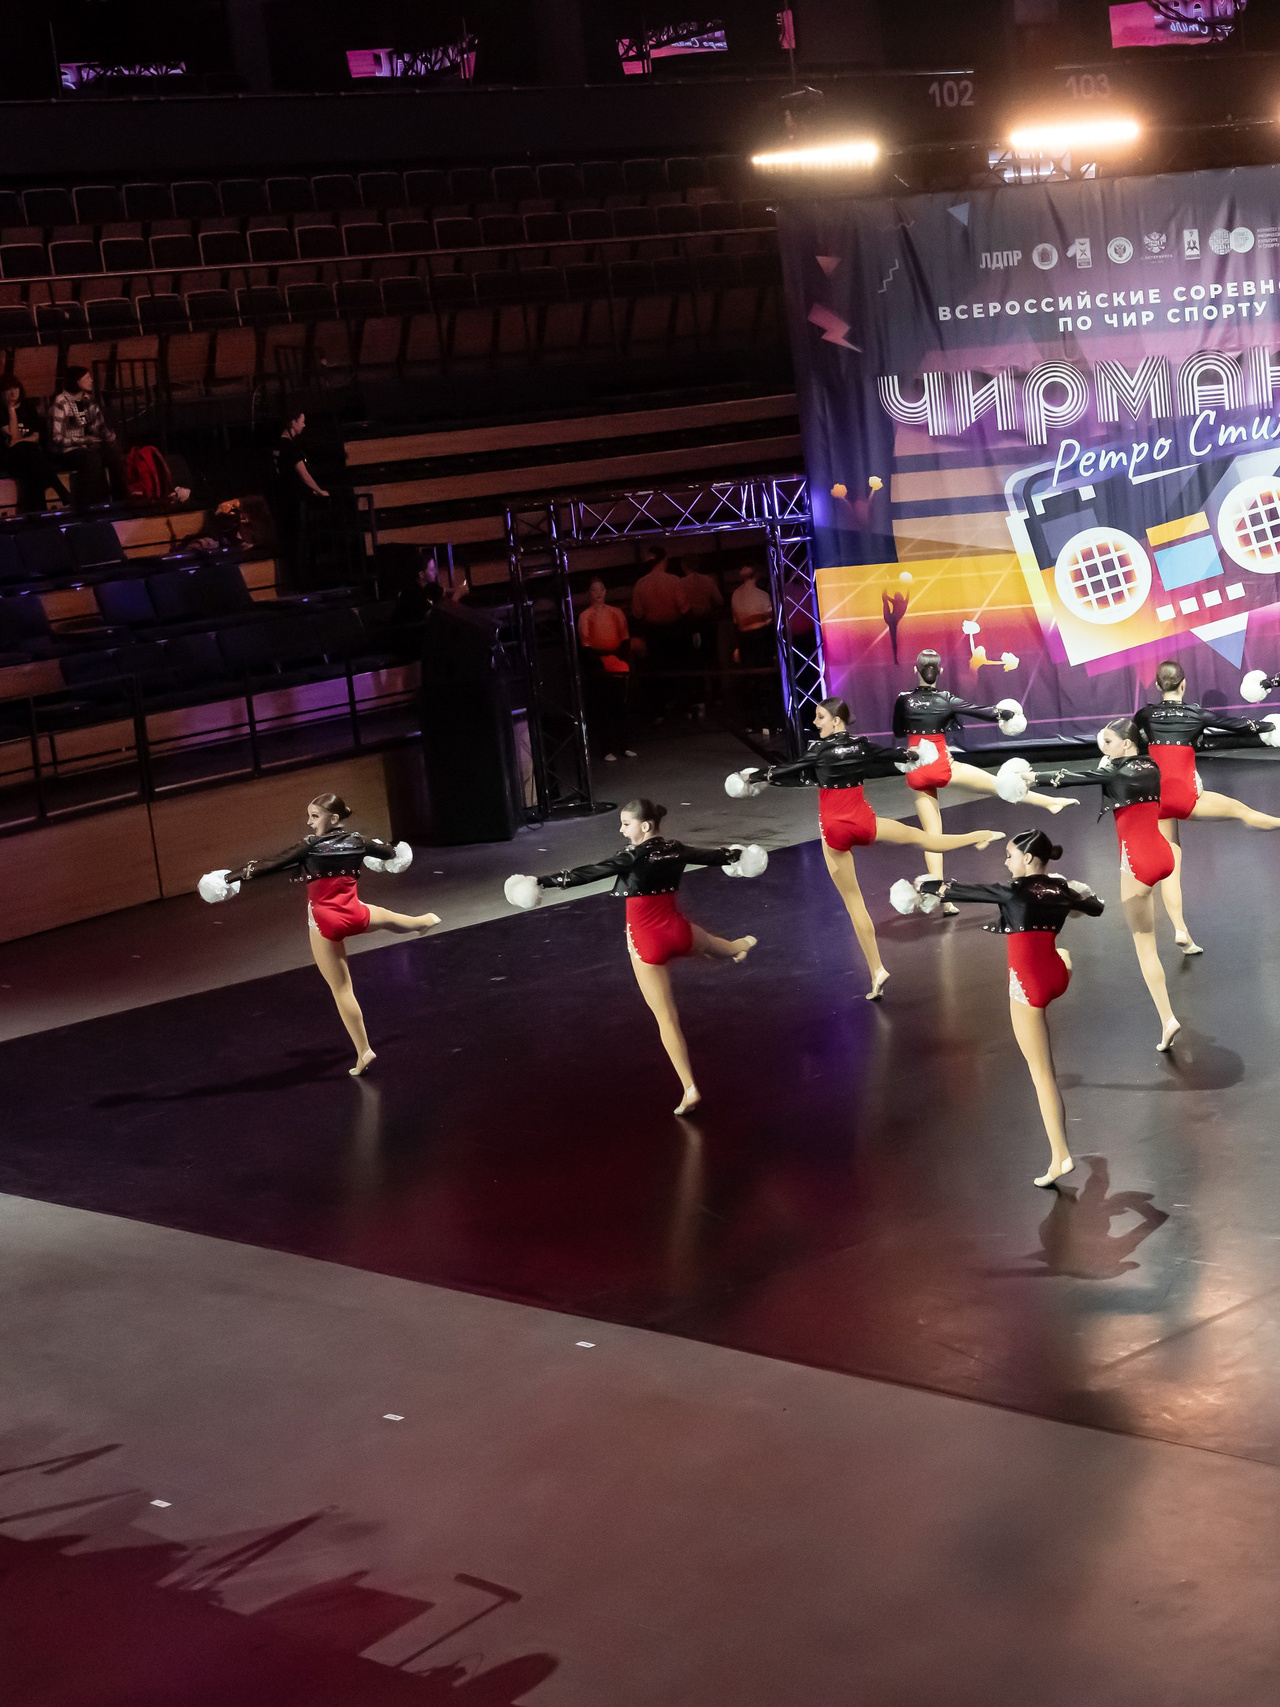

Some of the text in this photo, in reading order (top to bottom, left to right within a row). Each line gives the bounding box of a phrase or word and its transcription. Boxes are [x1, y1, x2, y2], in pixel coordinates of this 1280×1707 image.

[928, 80, 975, 108] 102
[1065, 72, 1114, 100] 103
[979, 250, 1022, 270] ЛДПР
[938, 287, 1161, 321] ВСЕРОССИЙСКИЕ
[1058, 301, 1268, 333] ПО ЧИР СПОРТУ
[1052, 438, 1174, 487] Ретро
